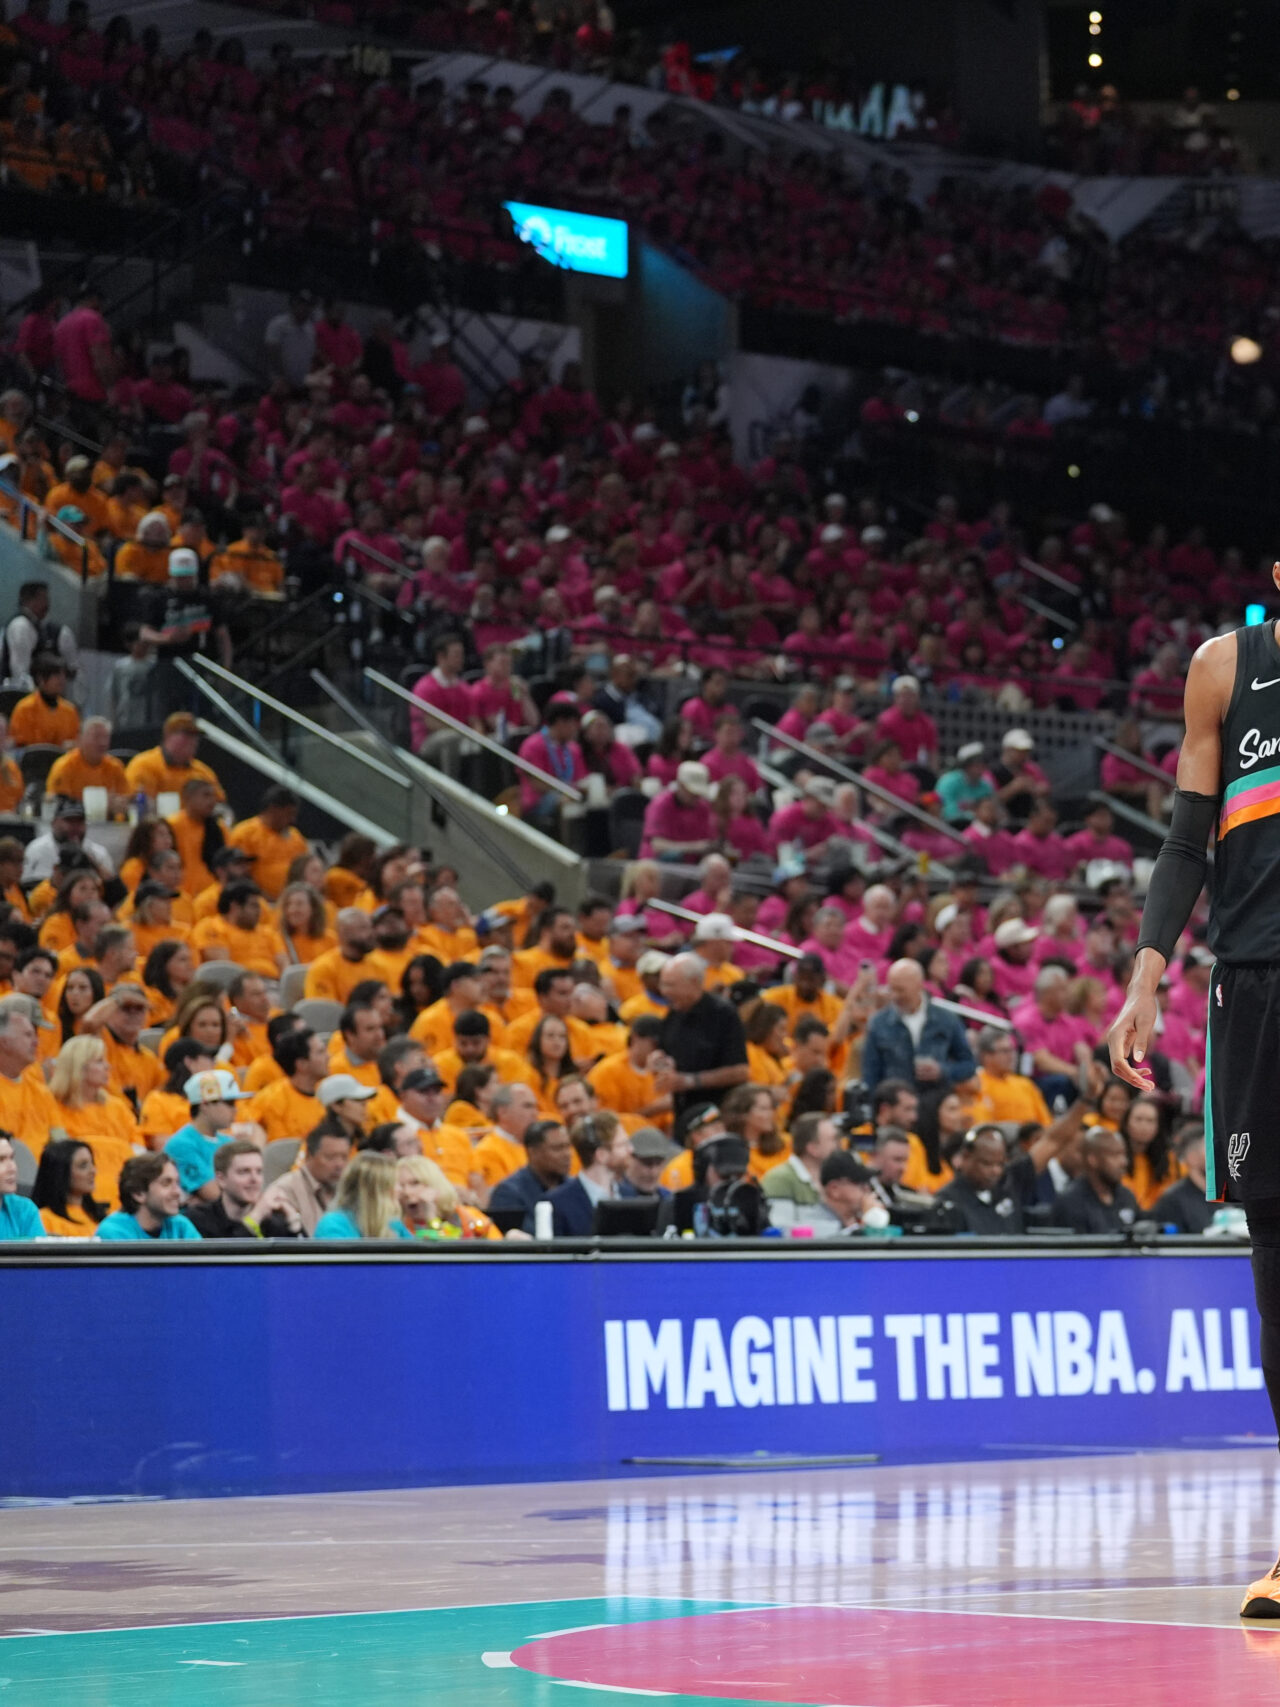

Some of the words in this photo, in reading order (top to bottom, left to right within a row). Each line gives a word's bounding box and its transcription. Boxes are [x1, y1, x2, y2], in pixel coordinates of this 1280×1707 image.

[553, 225, 607, 260] Frost
[604, 1315, 877, 1412] IMAGINE
[884, 1312, 1003, 1401] THE
[1011, 1310, 1156, 1397] NBA.
[1165, 1308, 1264, 1392] ALL
